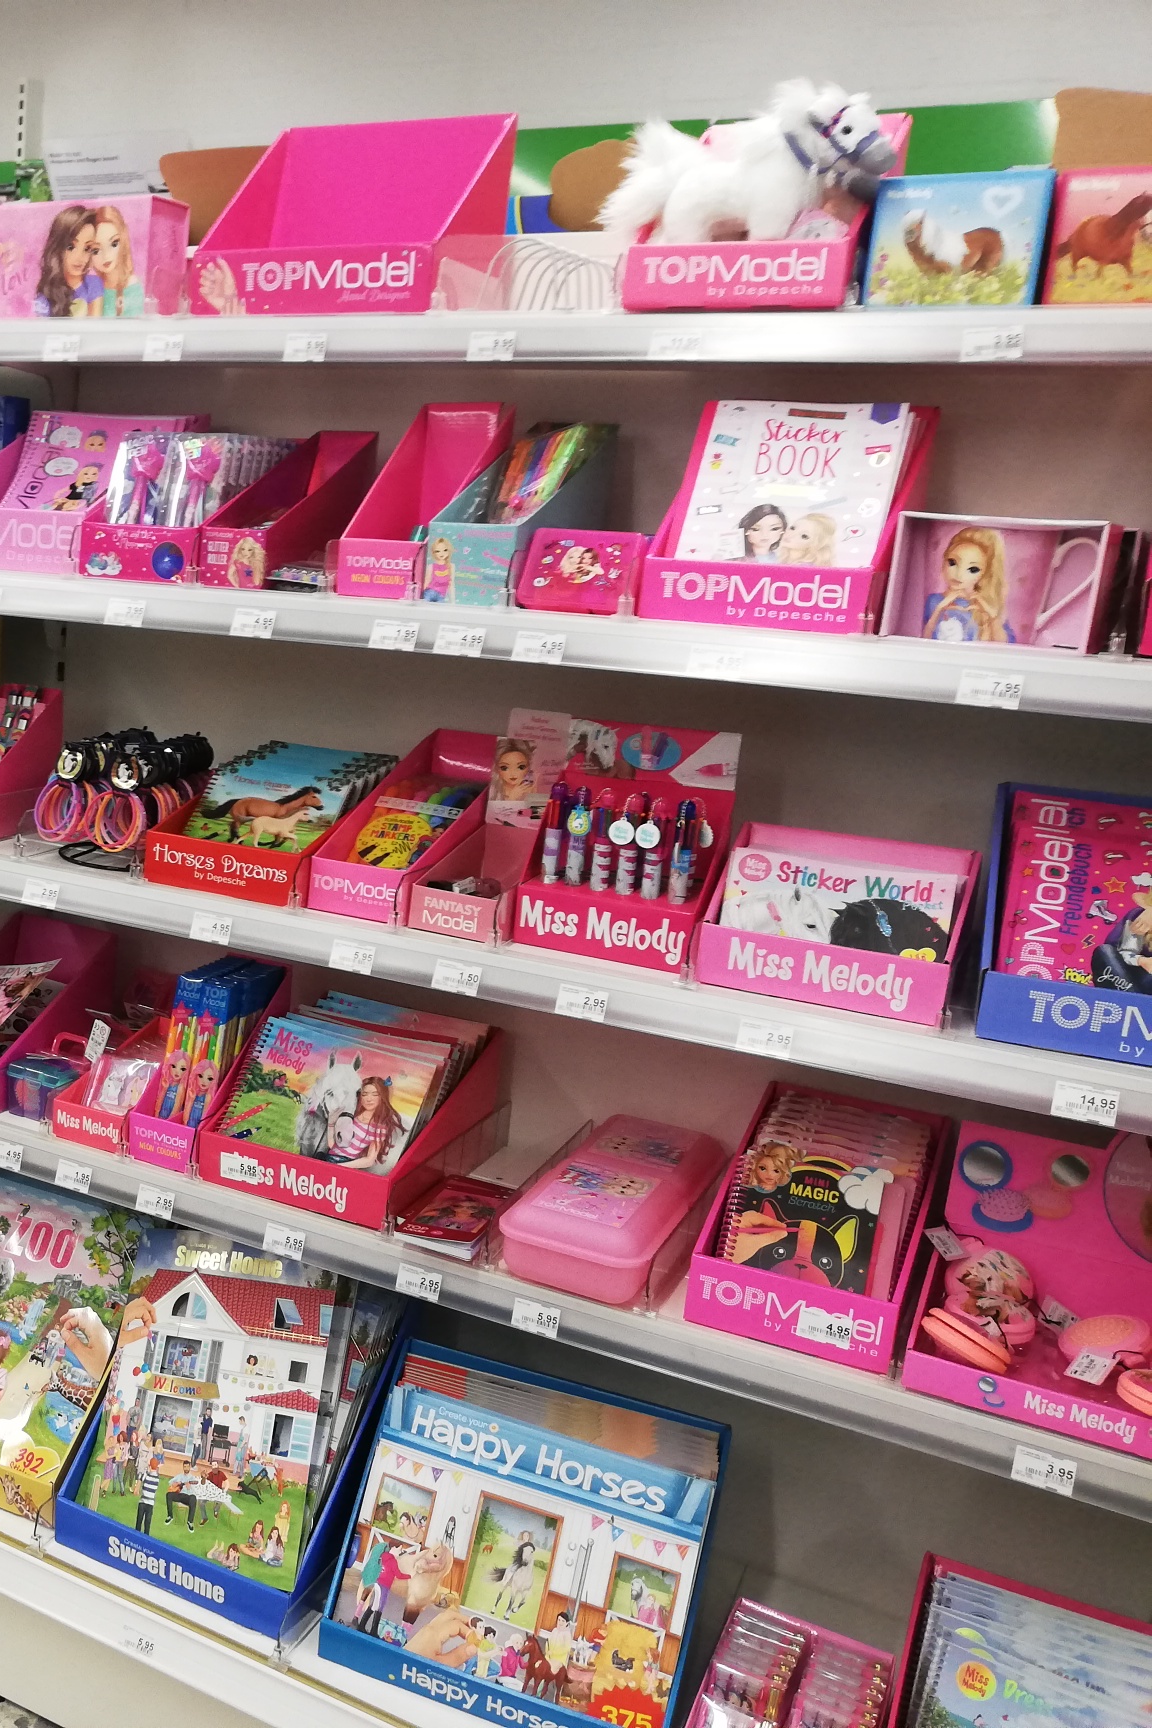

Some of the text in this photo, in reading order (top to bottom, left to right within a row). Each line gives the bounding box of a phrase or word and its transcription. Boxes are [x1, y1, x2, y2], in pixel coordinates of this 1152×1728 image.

[242, 250, 417, 291] TOPModel
[644, 249, 827, 285] TOPModel
[707, 283, 824, 297] by Depesche
[762, 417, 846, 446] Sticker
[755, 443, 842, 479] BOOK
[660, 570, 851, 609] TOPModel
[726, 605, 846, 623] by Depesche
[461, 634, 484, 645] 4.95
[541, 641, 563, 652] 4.95
[993, 681, 1020, 694] 7.95
[370, 829, 416, 842] MARKERS
[381, 822, 413, 834] STAMP
[153, 843, 288, 884] Horses Dreams
[194, 871, 247, 888] by Depesche
[777, 861, 935, 903] Sticker World
[42, 888, 58, 898] 2.95
[1059, 843, 1092, 937] Freundebuch
[424, 896, 482, 917] FANTASY
[1016, 832, 1076, 981] OPModel
[211, 922, 230, 933] 4.95
[422, 909, 478, 933] Model
[519, 895, 686, 966] Miss Melody
[354, 951, 373, 962] 5.95
[460, 972, 479, 983] 1.50
[728, 937, 913, 1012] Miss Melody
[1065, 968, 1092, 984] POW!
[1098, 966, 1134, 992] Jenny
[205, 986, 228, 999] TOP
[203, 997, 226, 1008] Model
[583, 997, 606, 1009] 2.95
[1029, 990, 1152, 1043] TOPM
[274, 1027, 313, 1056] Miss
[767, 1032, 791, 1045] 2.95
[1119, 1041, 1145, 1058] by
[266, 1046, 306, 1075] Melody
[1080, 1095, 1116, 1110] 14.95
[57, 1110, 119, 1142] Miss Melody
[134, 1126, 188, 1149] TOPModel
[6, 1150, 21, 1160] 4.95
[139, 1141, 182, 1160] NEON COLOURS
[75, 1172, 90, 1182] 1.95
[240, 1163, 257, 1174] 5.95
[279, 1163, 348, 1212] Melody
[805, 1174, 830, 1190] MINI
[156, 1196, 172, 1208] 2.95
[788, 1194, 836, 1213] Scratch
[789, 1183, 840, 1205] MAGIC
[6, 1213, 77, 1268] ZOO
[285, 1236, 303, 1248] 5.95
[175, 1246, 283, 1279] Sweet Home
[420, 1277, 440, 1290] 2.95
[537, 1312, 558, 1325] 5.95
[699, 1274, 884, 1346] TOPMel
[763, 1317, 782, 1333] by
[826, 1323, 850, 1337] 4.95
[152, 1376, 203, 1396] Welcome
[438, 1405, 489, 1431] Create your
[1024, 1391, 1137, 1444] Miss Melody
[15, 1447, 44, 1474] 392
[411, 1404, 667, 1514] Happy Horses
[1046, 1464, 1073, 1480] 3.95
[123, 1538, 142, 1551] Create
[108, 1535, 225, 1604] Sweet Home
[138, 1637, 154, 1651] 5.95
[965, 1664, 990, 1687] Miss
[401, 1664, 568, 1728] Happy Horse
[962, 1678, 986, 1698] Melody
[600, 1705, 652, 1728] 375
